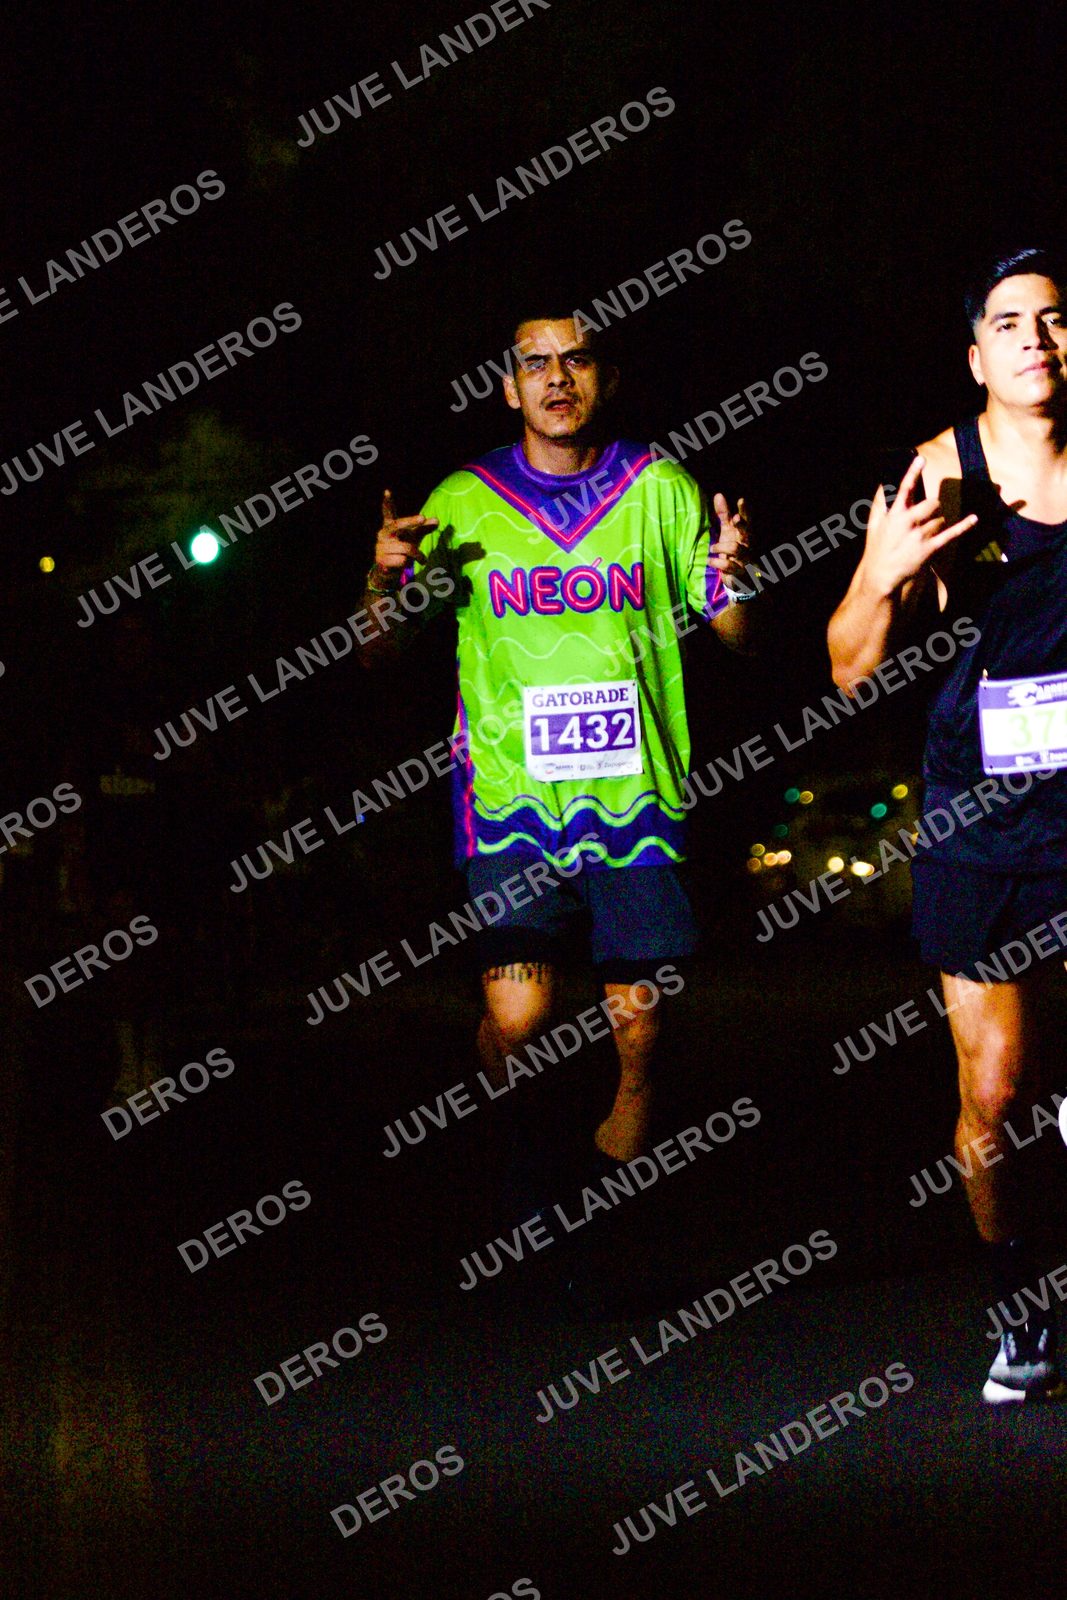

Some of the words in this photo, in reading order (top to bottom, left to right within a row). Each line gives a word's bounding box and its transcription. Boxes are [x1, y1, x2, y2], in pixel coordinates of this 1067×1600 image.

[489, 557, 645, 618] NEÓN
[532, 688, 629, 708] GATORADE
[534, 712, 634, 752] 1432
[1008, 709, 1067, 748] 37
